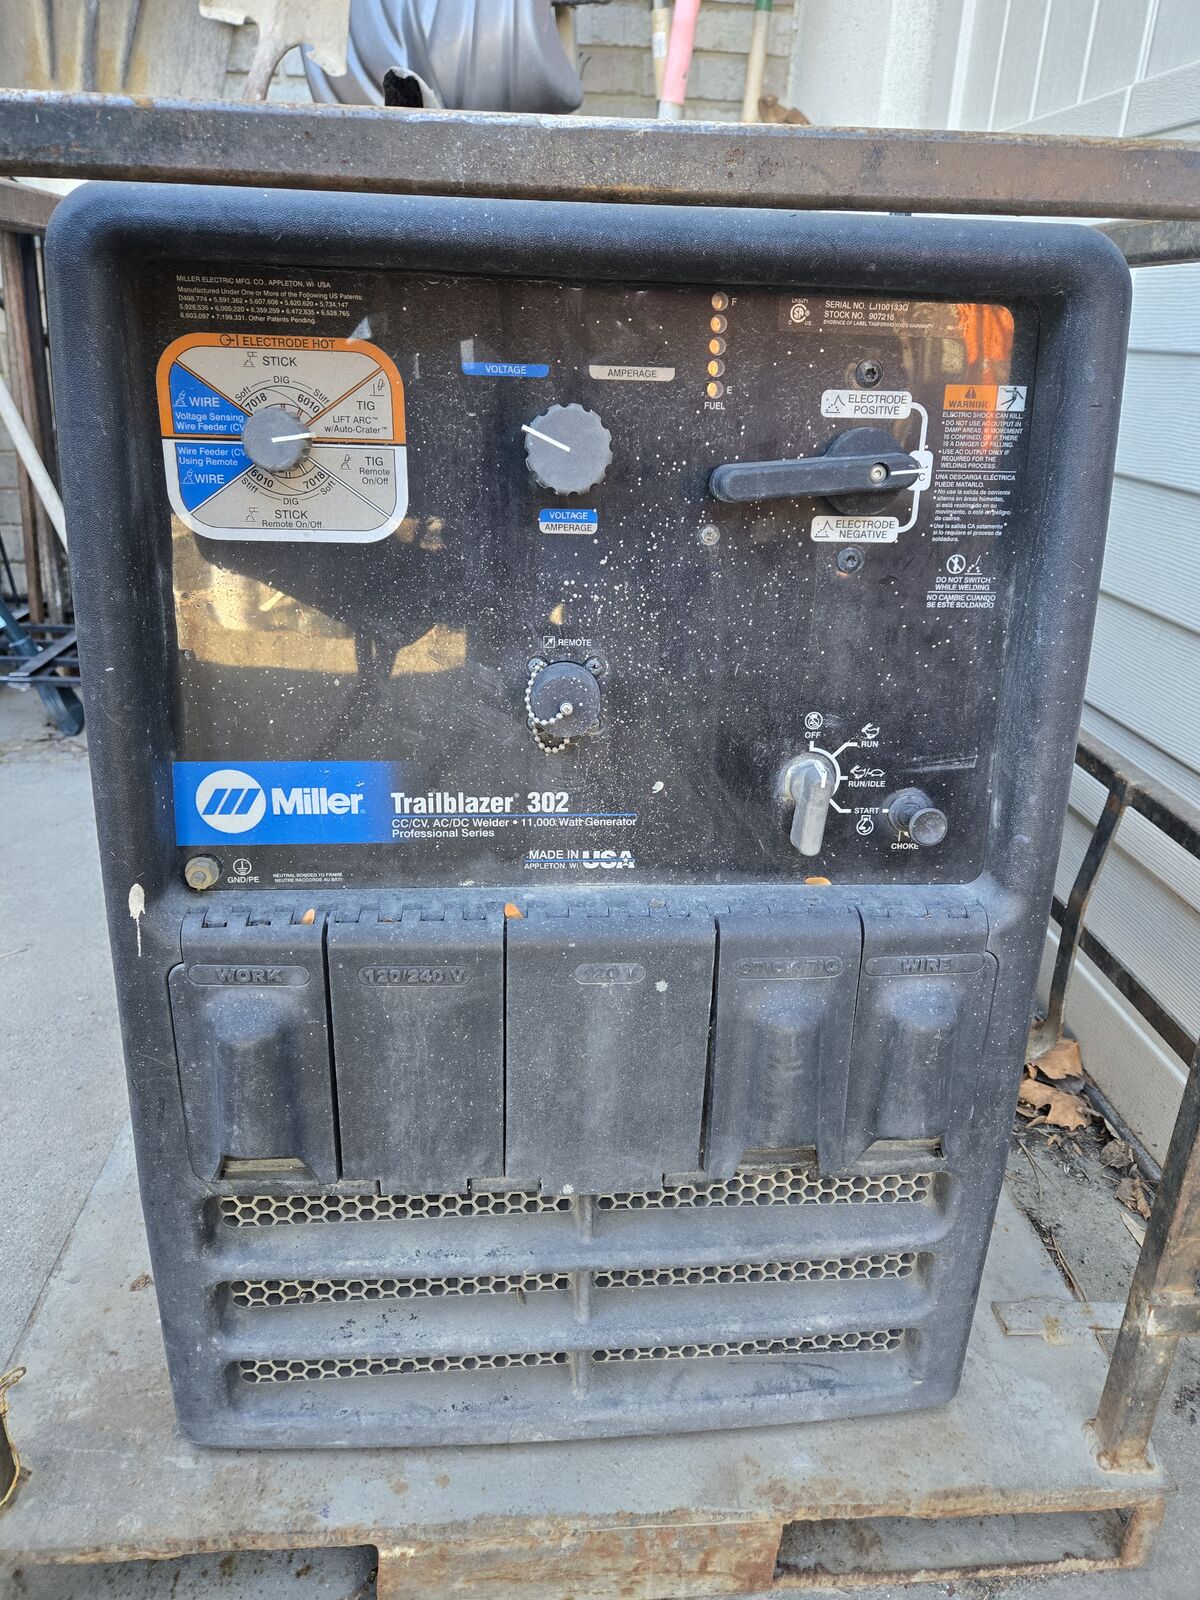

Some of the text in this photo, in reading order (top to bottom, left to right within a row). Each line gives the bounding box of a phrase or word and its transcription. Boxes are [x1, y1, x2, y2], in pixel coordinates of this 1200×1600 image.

[176, 275, 200, 284] MILLER
[202, 276, 234, 285] ELECTRIC
[317, 281, 332, 289] USA
[177, 286, 220, 295] Manufactured
[221, 288, 240, 296] Under
[242, 289, 255, 297] One
[263, 290, 280, 298] More
[299, 291, 328, 301] Following
[329, 292, 339, 300] US
[730, 297, 738, 306] F
[825, 301, 851, 310] SERIAL
[823, 310, 850, 320] STOCK
[869, 313, 895, 322] 907216
[243, 337, 336, 349] ELECTRODE HOT
[262, 356, 298, 367] STICK
[485, 365, 527, 375] VOLTAGE
[607, 369, 658, 378] AMPERAGE
[273, 376, 290, 385] DIG
[235, 386, 251, 402] Soft
[726, 386, 733, 395] E
[189, 396, 221, 408] WIRE
[246, 392, 267, 411] 7018
[313, 389, 330, 405] Stiff
[848, 394, 908, 404] ELECTRODE
[297, 393, 321, 413] 6010
[356, 401, 375, 411] TIG
[704, 401, 726, 410] FUEL
[948, 400, 991, 410] WARNING
[854, 406, 900, 415] POSITIVE
[175, 412, 244, 423] Voltage Sensing
[332, 415, 351, 424] LIFT
[176, 421, 196, 431] Wire
[198, 422, 227, 432] Feeder
[177, 446, 197, 455] Wire
[199, 447, 228, 456] Feeder
[179, 456, 239, 467] Using Remote
[364, 456, 384, 466] TIG
[359, 467, 391, 476] Remote
[194, 474, 225, 484] WIRE
[251, 467, 275, 488] 6010
[302, 471, 326, 490] 7018
[362, 476, 388, 486] On/Off
[241, 477, 259, 494] Stiff
[320, 479, 336, 496] Soft
[283, 497, 299, 506] DIG
[274, 509, 309, 520] STICK
[549, 511, 589, 521] VOLTAGE
[261, 519, 322, 530] Remote On/Off
[544, 523, 594, 533] AMPERAGE
[836, 519, 896, 530] ELECTRODE
[839, 529, 888, 539] NEGATIVE
[935, 576, 947, 584] DO
[948, 576, 963, 584] NOT
[557, 638, 592, 647] REMOTE
[848, 780, 886, 788] RUN/IDLE
[527, 791, 570, 813] 302
[434, 818, 470, 829] AC/DC
[473, 818, 510, 828] Welder
[521, 818, 557, 829] 11,000
[557, 817, 583, 828] Watt
[585, 816, 637, 828] Generator
[392, 828, 495, 839] Professional Series
[891, 842, 919, 850] CHOKE
[529, 850, 579, 860] MADE IN
[582, 850, 636, 869] USA
[227, 876, 260, 884] GND/PE
[899, 957, 951, 974] WIRE
[217, 968, 283, 984] WORK
[365, 968, 466, 984] 120/240 V
